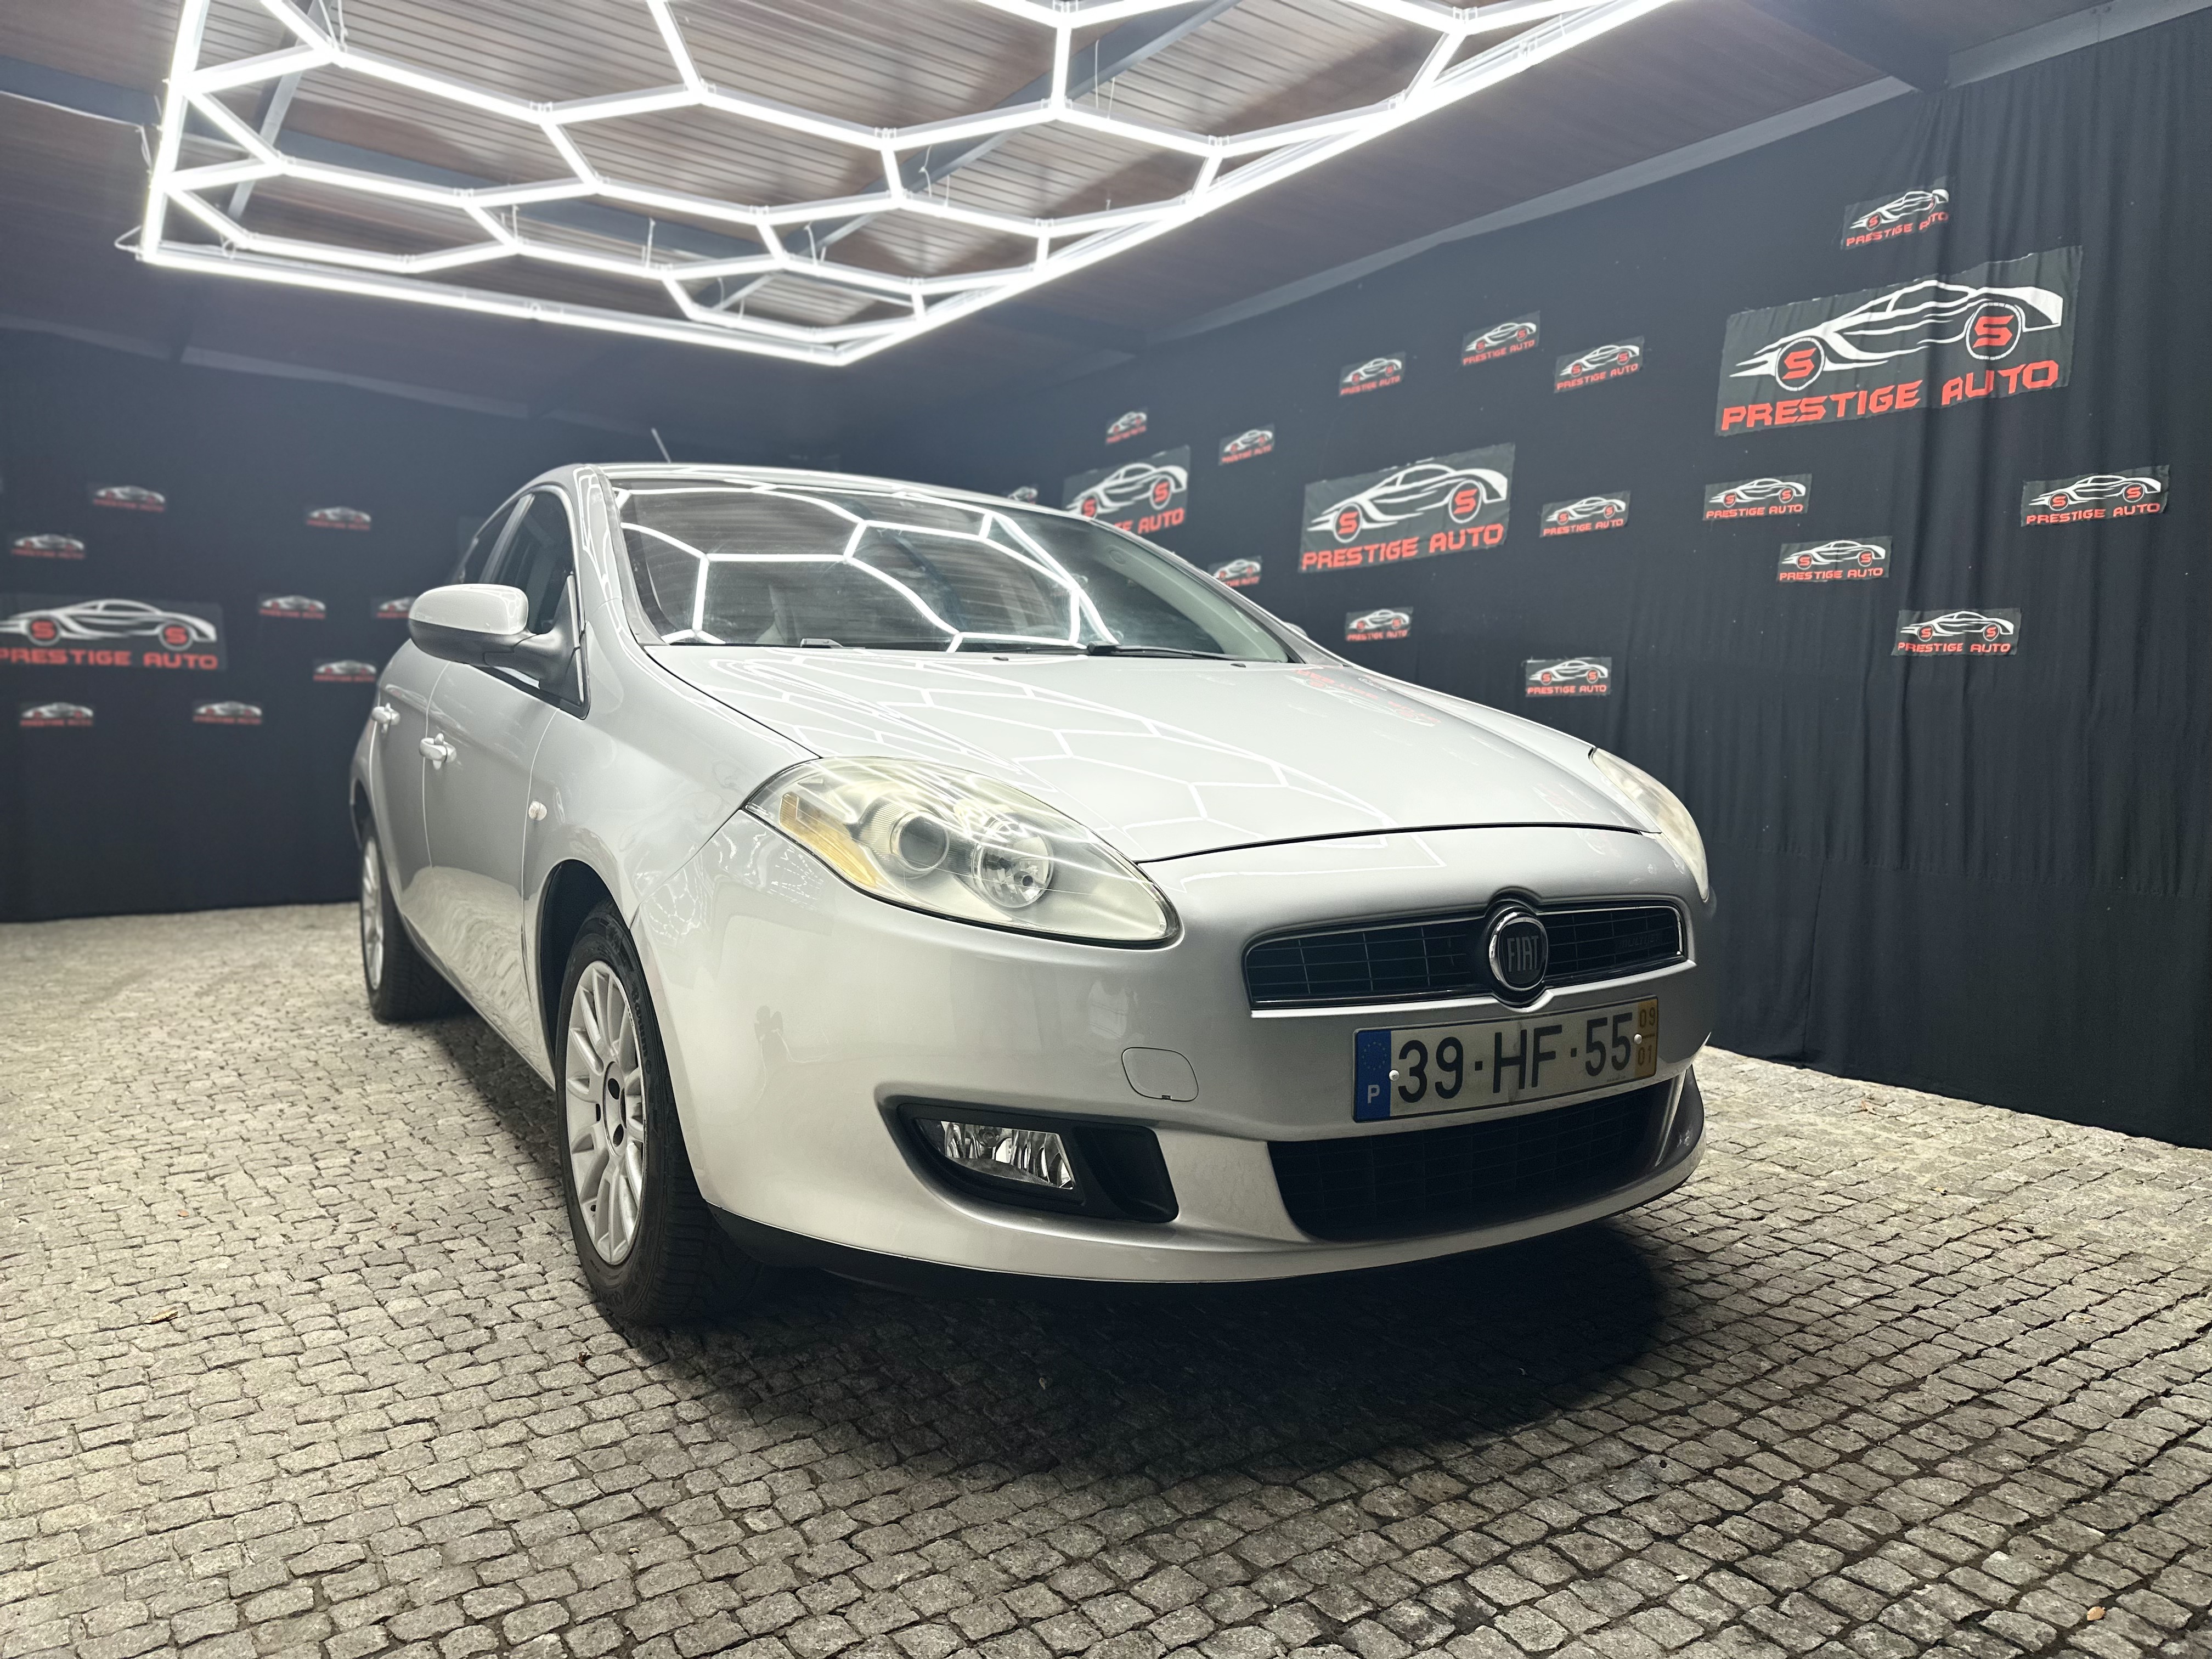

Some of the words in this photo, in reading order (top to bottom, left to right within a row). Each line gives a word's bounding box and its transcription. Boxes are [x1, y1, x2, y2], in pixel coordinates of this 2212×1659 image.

[1846, 223, 1913, 246] PRESTIGE
[1973, 315, 2014, 348] S
[1463, 348, 1506, 364] PRESTIGE
[1510, 340, 1535, 353] AUTO
[1782, 348, 1816, 380] S
[1556, 373, 1606, 390] PRESTIGE
[1610, 363, 1638, 377] AUTO
[1721, 380, 1922, 431] PRESTIGE
[1941, 360, 2059, 406] AUTO
[1154, 482, 1170, 503] S
[1453, 488, 1478, 515] S
[2052, 495, 2067, 507] S
[2127, 487, 2141, 499] S
[1138, 508, 1184, 534] AUTO
[1706, 507, 1765, 518] PRESTIGE
[1768, 503, 1803, 515] AUTO
[2026, 509, 2106, 524] PRESTIGE
[2113, 503, 2160, 517] AUTO
[1338, 511, 1358, 534] S
[1543, 523, 1592, 536] PRESTIGE
[1595, 518, 1624, 531] AUTO
[1301, 537, 1419, 570] PRESTIGE
[1429, 523, 1504, 553] AUTO
[1779, 569, 1843, 581] PRESTIGE
[1847, 567, 1884, 579] AUTO
[31, 621, 55, 639] S
[165, 627, 187, 644] S
[1898, 642, 1963, 653] PRESTIGE
[1970, 643, 2011, 653] AUTO
[0, 648, 131, 666] PRESTIGE
[143, 652, 218, 669] AUTO
[1527, 685, 1576, 695] PRESTIGE
[1579, 684, 1607, 694] AUTO
[1507, 935, 1539, 972] FIAT
[1640, 1007, 1655, 1028] 09
[1638, 1045, 1652, 1065] 01
[1367, 1084, 1380, 1104] P
